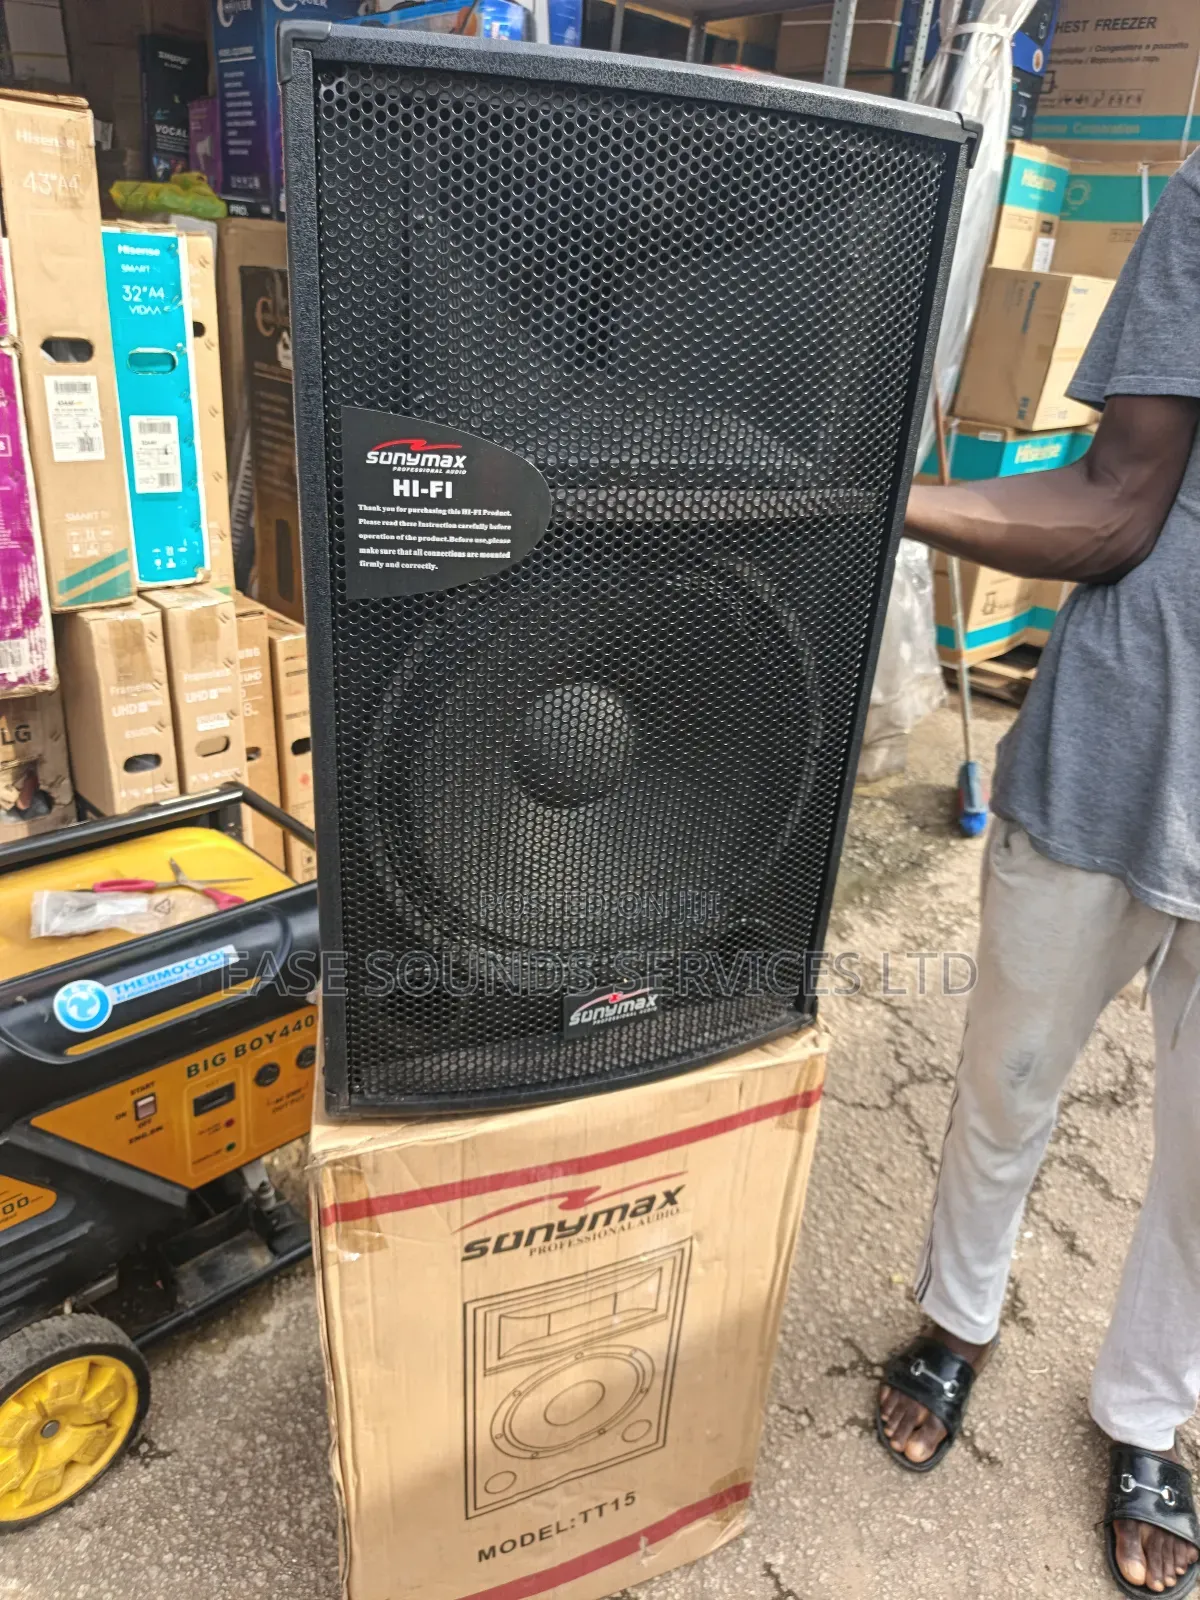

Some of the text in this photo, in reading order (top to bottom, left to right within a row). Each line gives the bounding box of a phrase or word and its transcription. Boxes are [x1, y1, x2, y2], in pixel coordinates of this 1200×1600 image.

[1055, 20, 1089, 34] HEST
[1094, 16, 1157, 31] FREEZER
[155, 123, 187, 138] VOCAL
[392, 466, 443, 474] PROFESSIONAL
[393, 479, 452, 499] HI-FI
[358, 504, 381, 512] Thank
[408, 507, 447, 515] purchasing
[462, 508, 482, 516] HI-FI
[482, 509, 512, 517] Product.
[418, 521, 457, 529] Instruction
[458, 522, 488, 531] carefully
[359, 547, 379, 555] make
[397, 548, 412, 556] that
[424, 550, 466, 558] connections
[479, 551, 511, 559] mounted
[359, 560, 384, 569] firmly
[401, 562, 438, 571] correctly.
[1, 724, 31, 745] LG
[593, 1012, 637, 1025] PROFESSIONAL
[186, 1052, 227, 1078] BIG
[130, 1081, 155, 1095] START
[529, 1206, 680, 1257] PROFESSIONAL AUDIO
